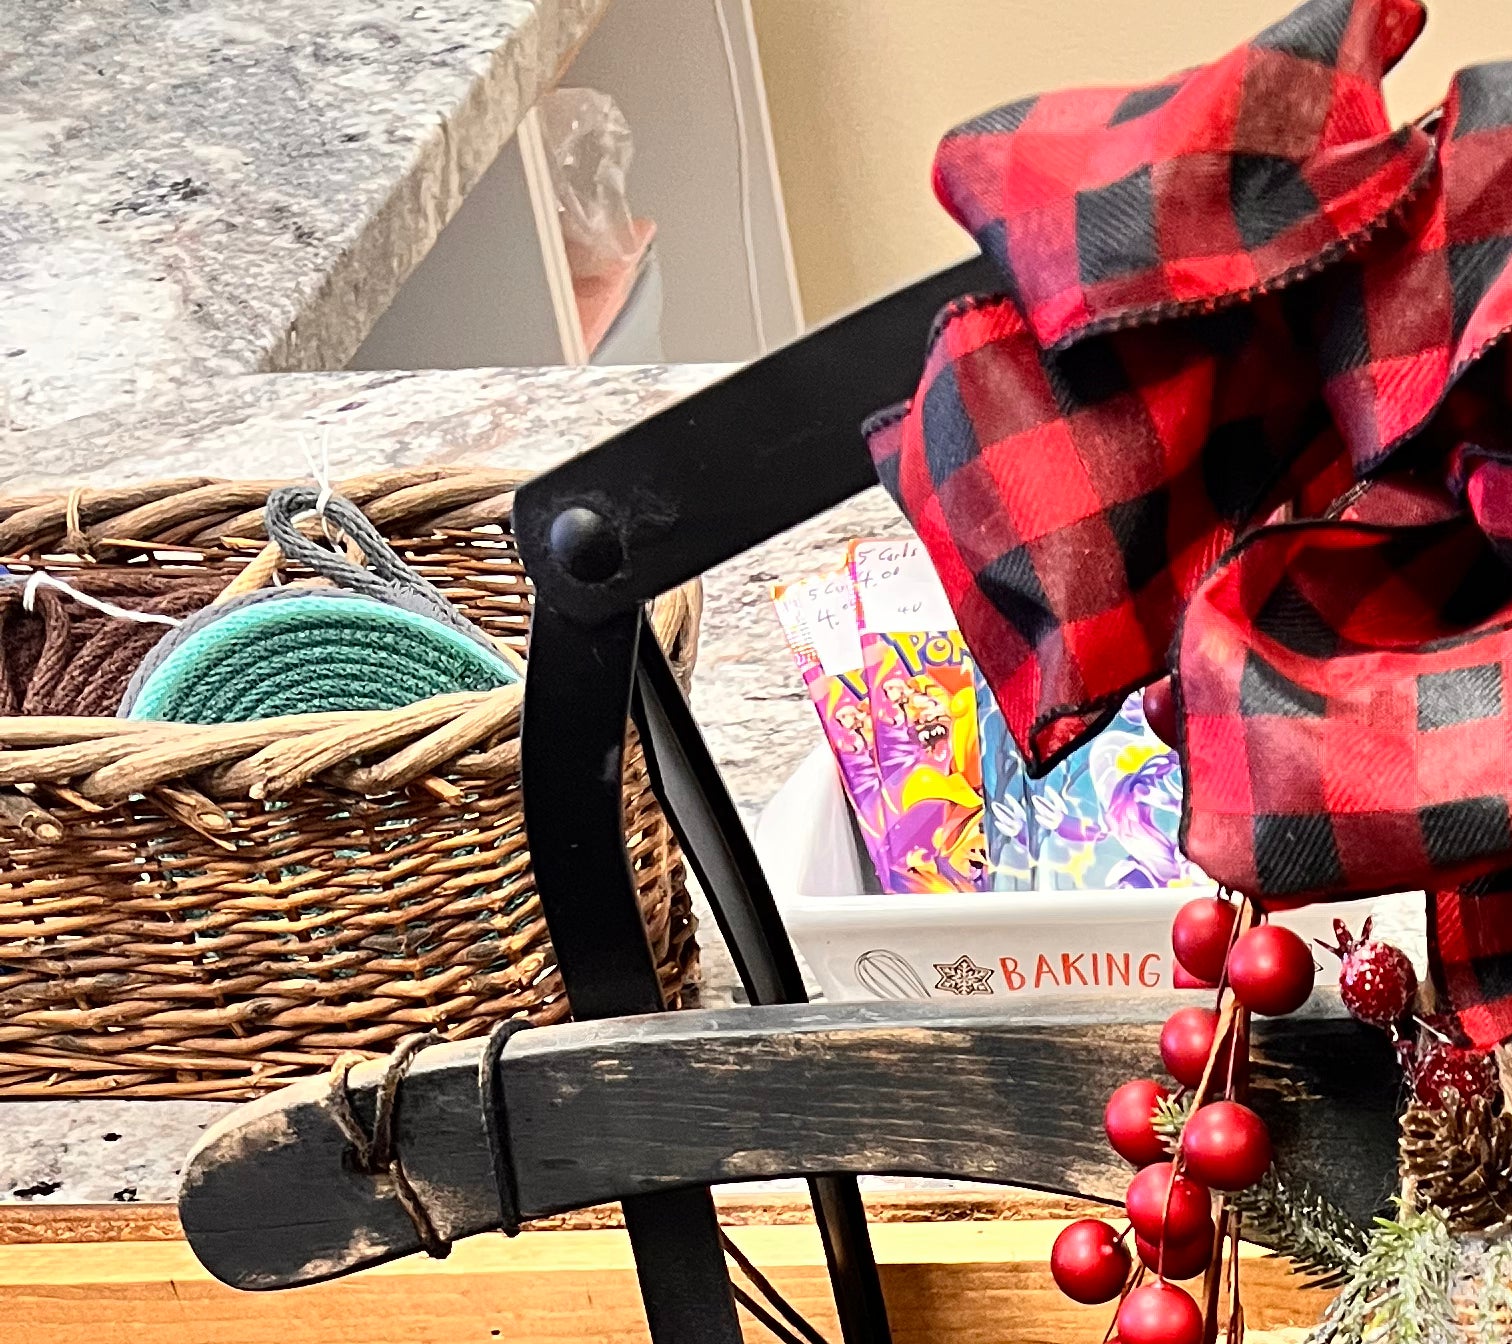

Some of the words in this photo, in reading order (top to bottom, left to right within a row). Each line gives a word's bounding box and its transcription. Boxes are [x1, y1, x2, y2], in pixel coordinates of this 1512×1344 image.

[858, 547, 877, 566] 5
[808, 588, 818, 601] 5
[999, 953, 1162, 991] BAKING
